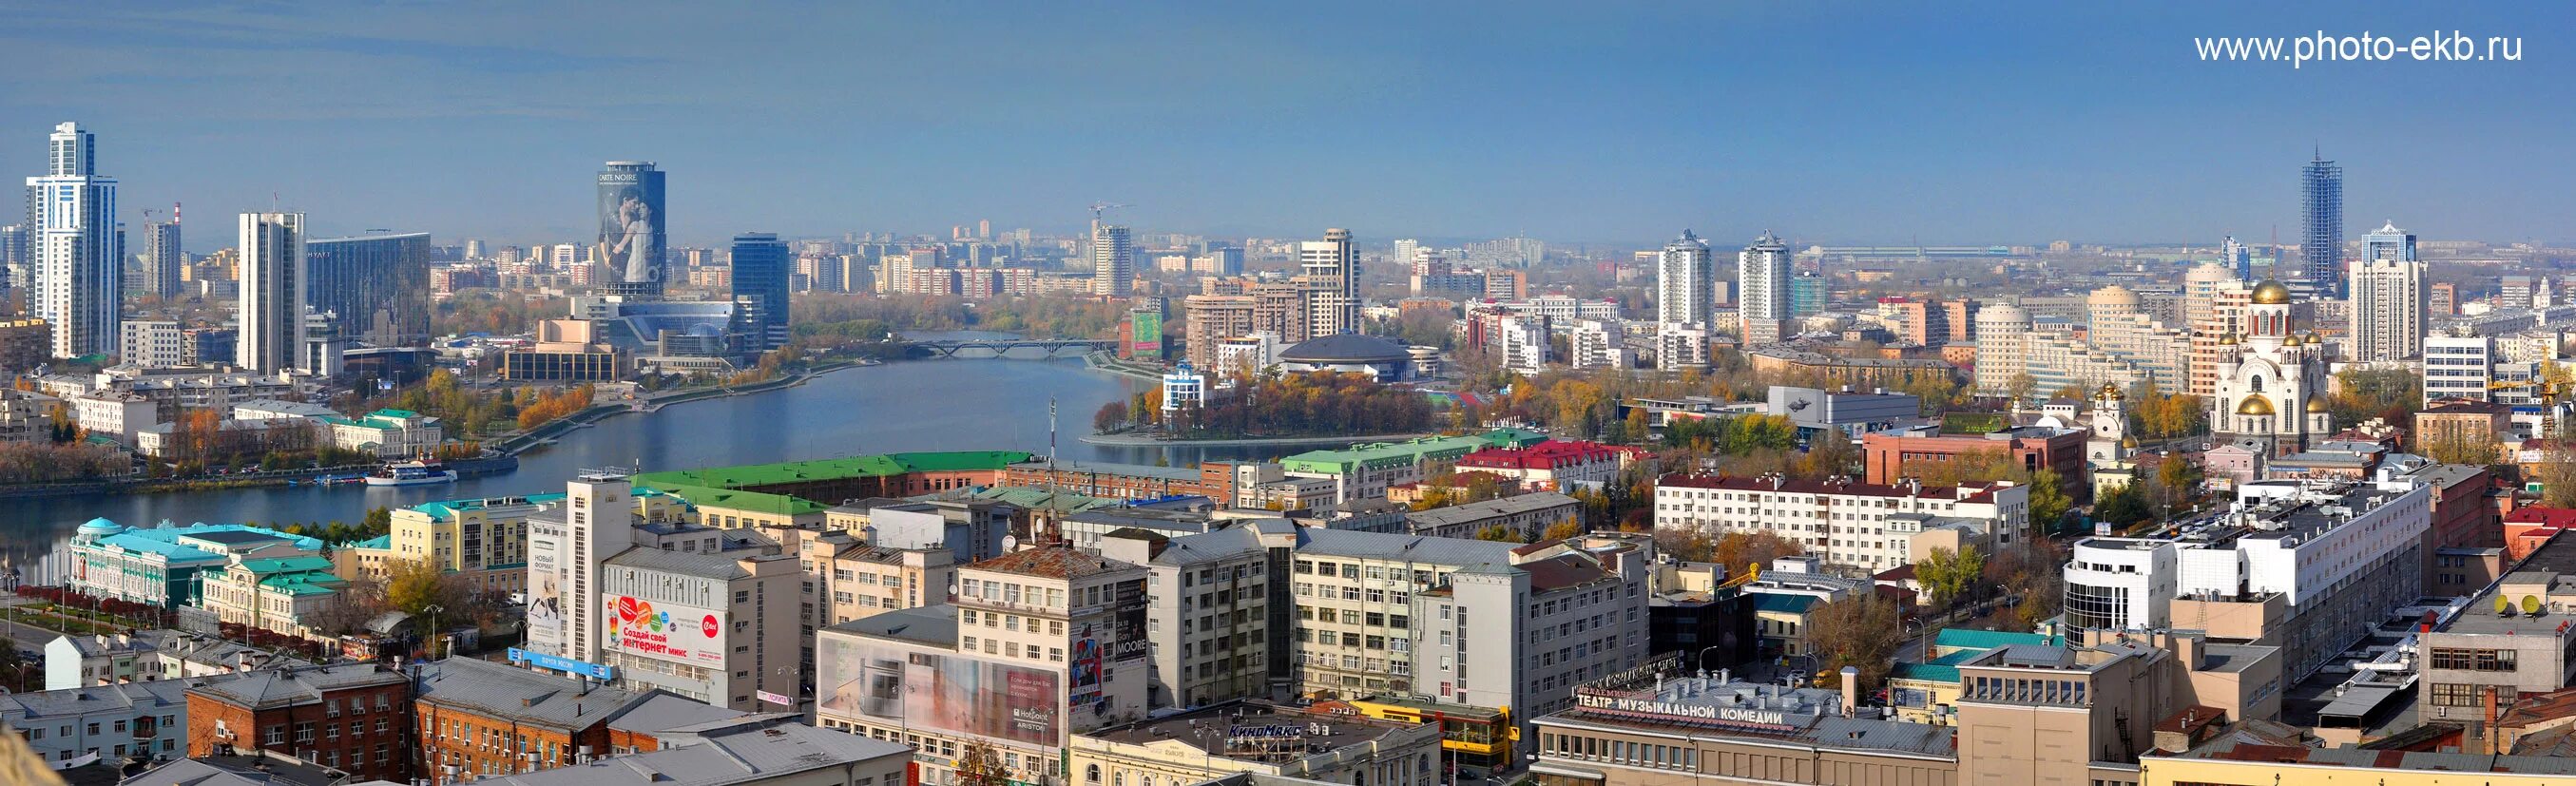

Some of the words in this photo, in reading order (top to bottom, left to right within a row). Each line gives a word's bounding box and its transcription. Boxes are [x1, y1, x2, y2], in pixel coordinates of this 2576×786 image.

[534, 554, 554, 564] НОВЫЙ
[534, 562, 554, 570] ФОРМАТ
[623, 626, 649, 641] Создай
[650, 633, 667, 643] свой
[623, 638, 667, 654] интернет
[668, 648, 687, 658] микс
[1116, 639, 1146, 655] MOORE
[1020, 709, 1048, 721] Hotpoint
[1577, 694, 1613, 708] ТЕАТР
[1618, 699, 1716, 719] МУЗЫКАЛЬНОЙ
[1721, 708, 1782, 725] КОМЕДИИ
